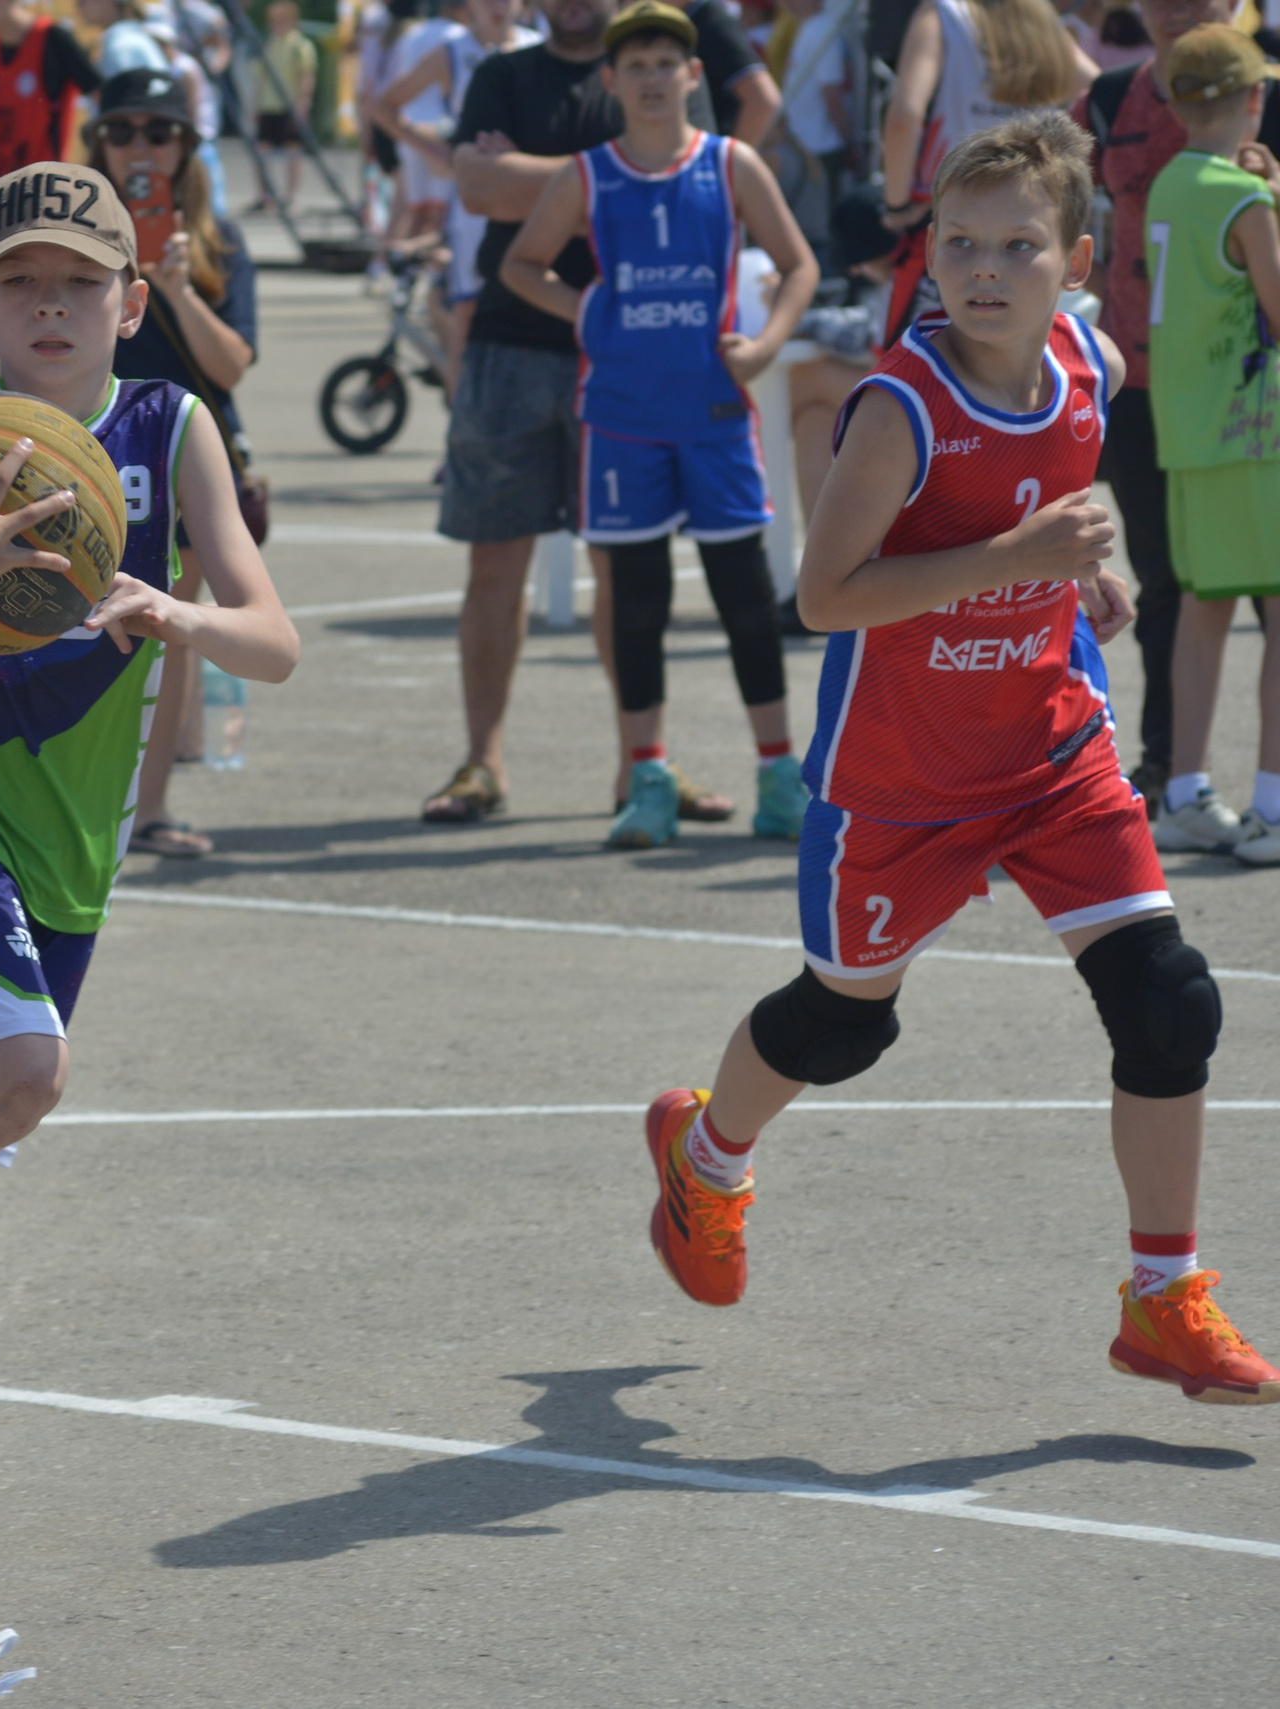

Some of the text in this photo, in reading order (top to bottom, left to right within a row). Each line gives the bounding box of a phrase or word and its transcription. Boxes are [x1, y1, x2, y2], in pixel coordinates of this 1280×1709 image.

[652, 204, 669, 248] 1
[604, 469, 619, 508] 1
[1014, 477, 1042, 530] 2
[865, 894, 895, 945] 2
